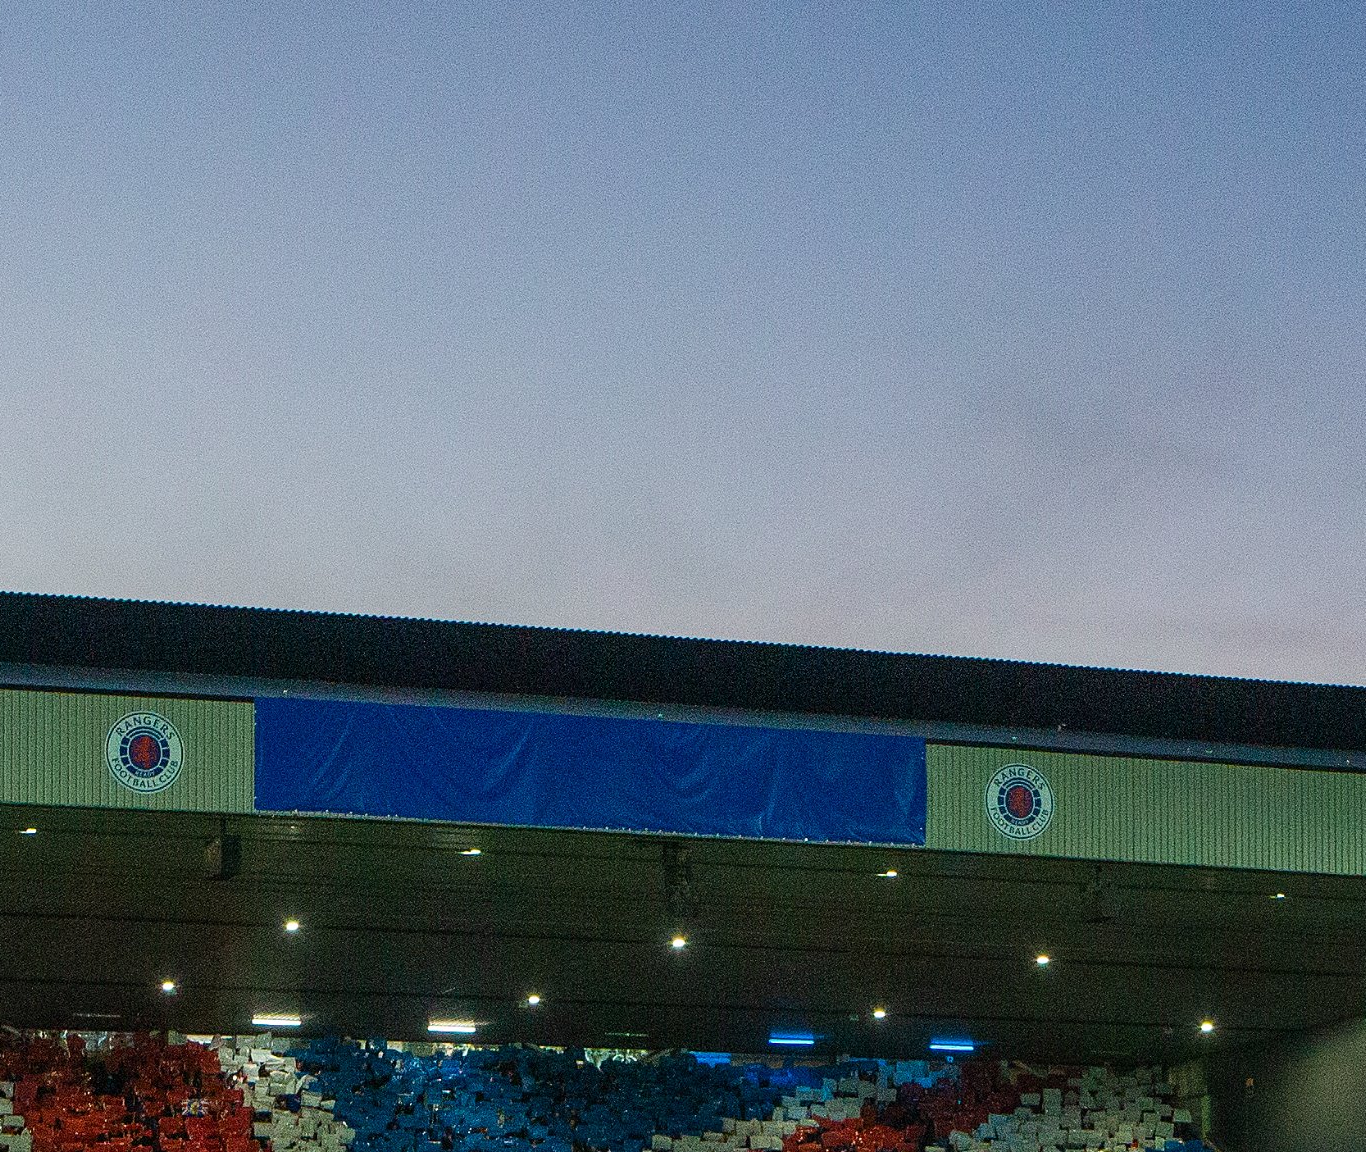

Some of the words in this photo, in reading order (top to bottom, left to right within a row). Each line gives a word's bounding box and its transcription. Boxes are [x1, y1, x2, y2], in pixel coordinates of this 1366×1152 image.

[115, 715, 176, 742] RANGERS
[112, 758, 156, 789] FOOTBALL
[159, 759, 179, 783] CLUB
[994, 767, 1046, 791] RANGERS
[990, 806, 1031, 836] FOOTBALL
